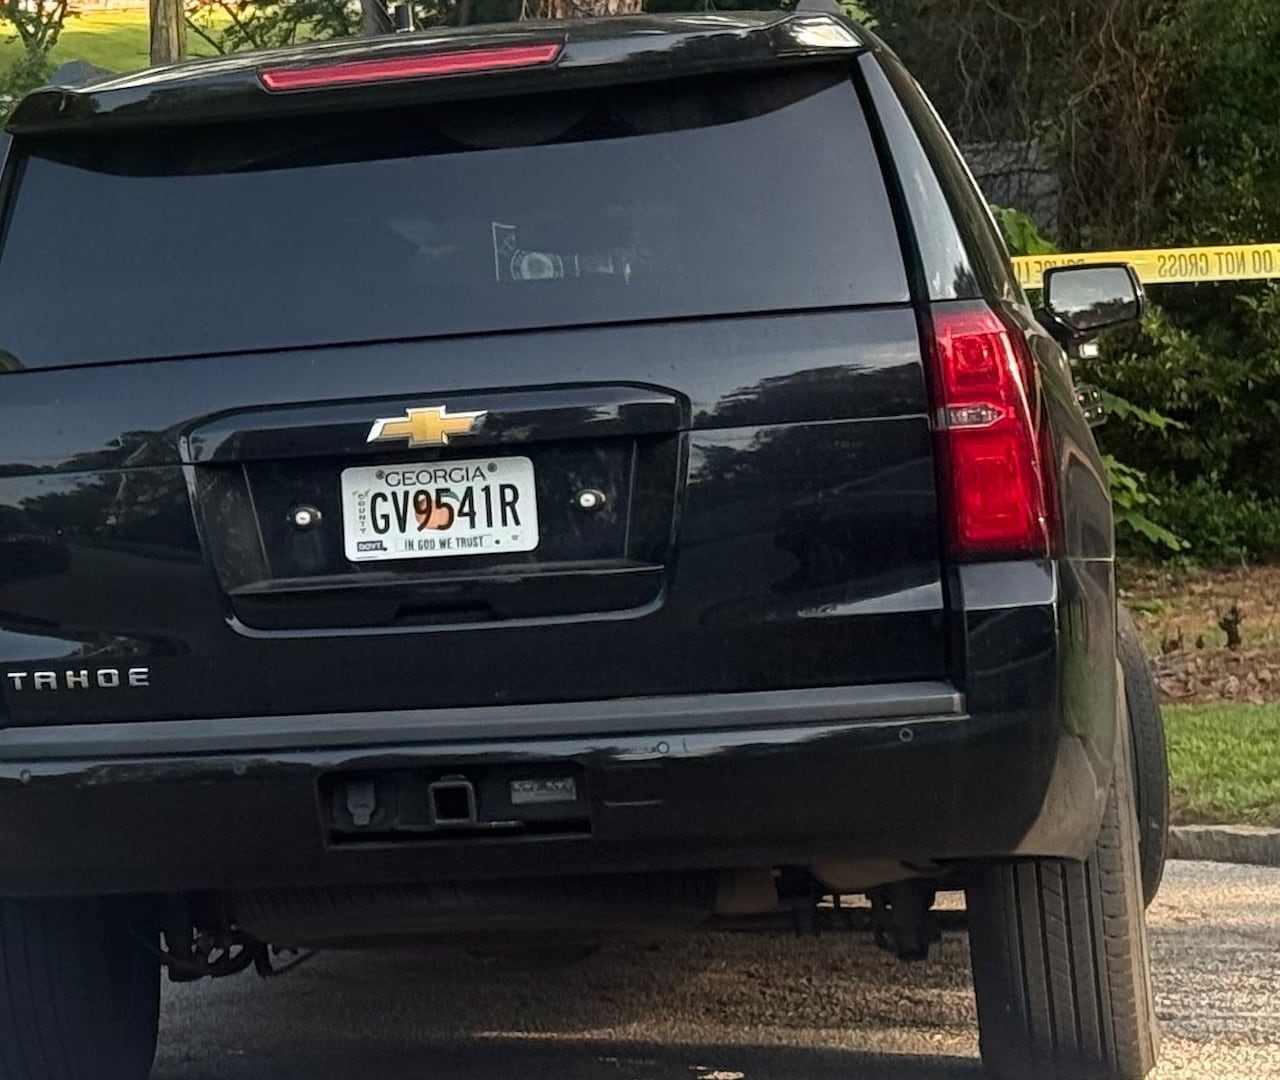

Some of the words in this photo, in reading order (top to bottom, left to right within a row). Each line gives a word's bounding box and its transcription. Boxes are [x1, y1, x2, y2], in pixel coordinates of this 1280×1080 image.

[384, 466, 488, 487] GEORGIA
[369, 483, 522, 535] GV9541R
[404, 540, 415, 551] IN
[417, 538, 436, 550] GOD
[439, 537, 453, 550] WE
[456, 535, 484, 549] TRUST
[6, 667, 150, 691] TAHOE
